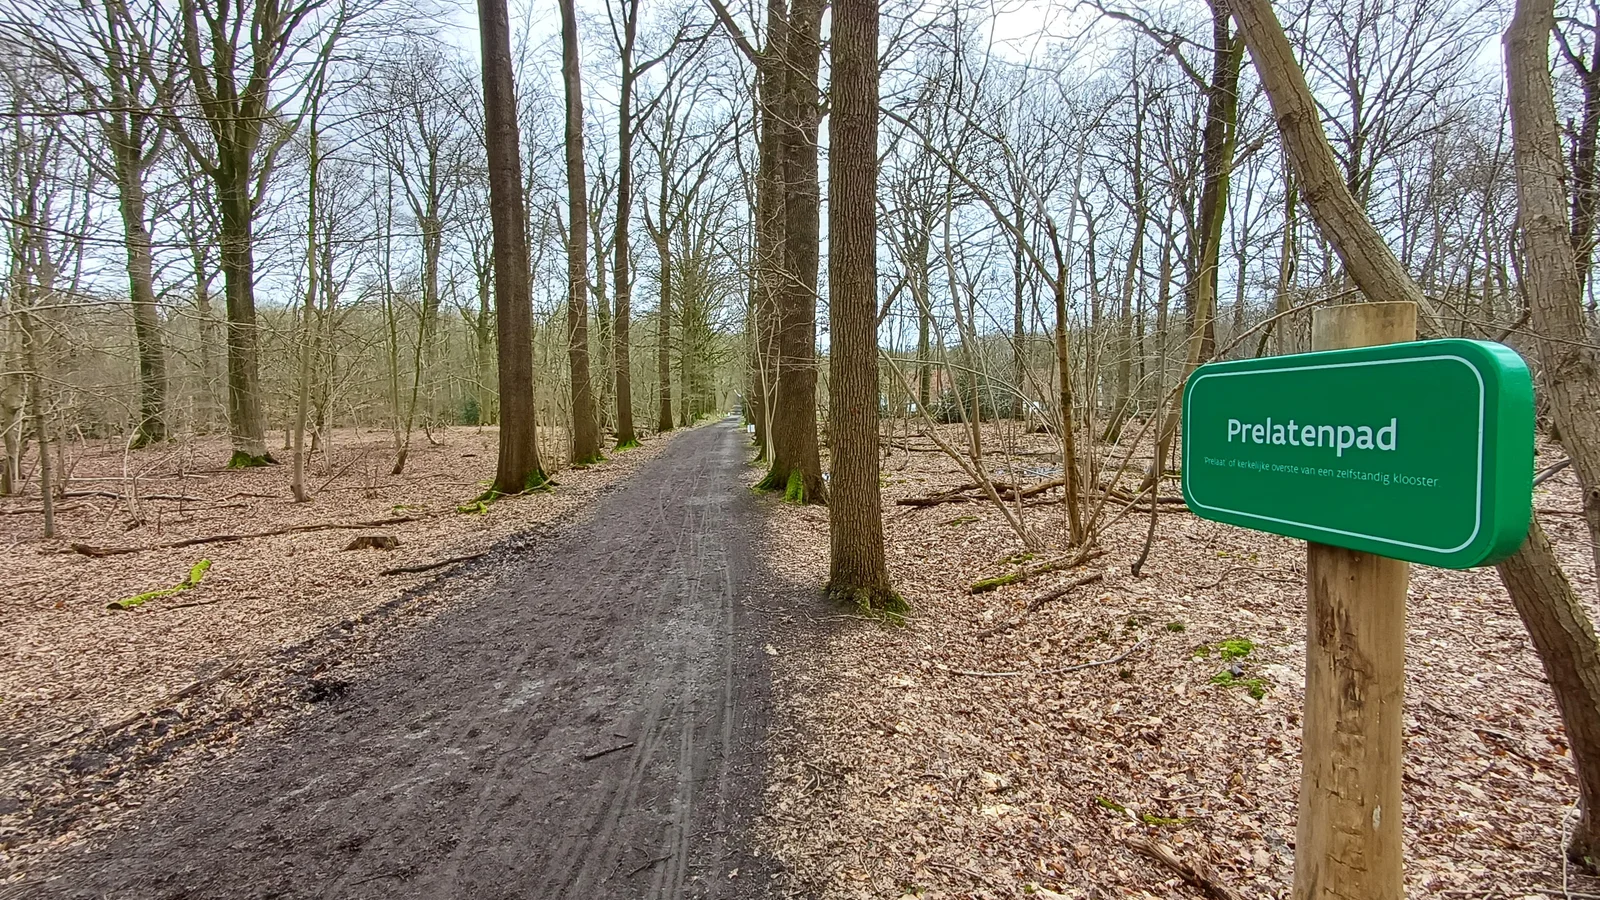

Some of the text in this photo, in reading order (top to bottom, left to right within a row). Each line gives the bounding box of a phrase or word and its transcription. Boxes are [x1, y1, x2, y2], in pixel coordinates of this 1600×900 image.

[1227, 416, 1398, 458] Prelatenpad
[1228, 458, 1237, 467] of
[1237, 459, 1270, 472] kerkelijke
[1271, 463, 1299, 474] overste
[1301, 466, 1316, 475] van
[1317, 468, 1334, 477] een
[1336, 469, 1391, 486] zelfstandig
